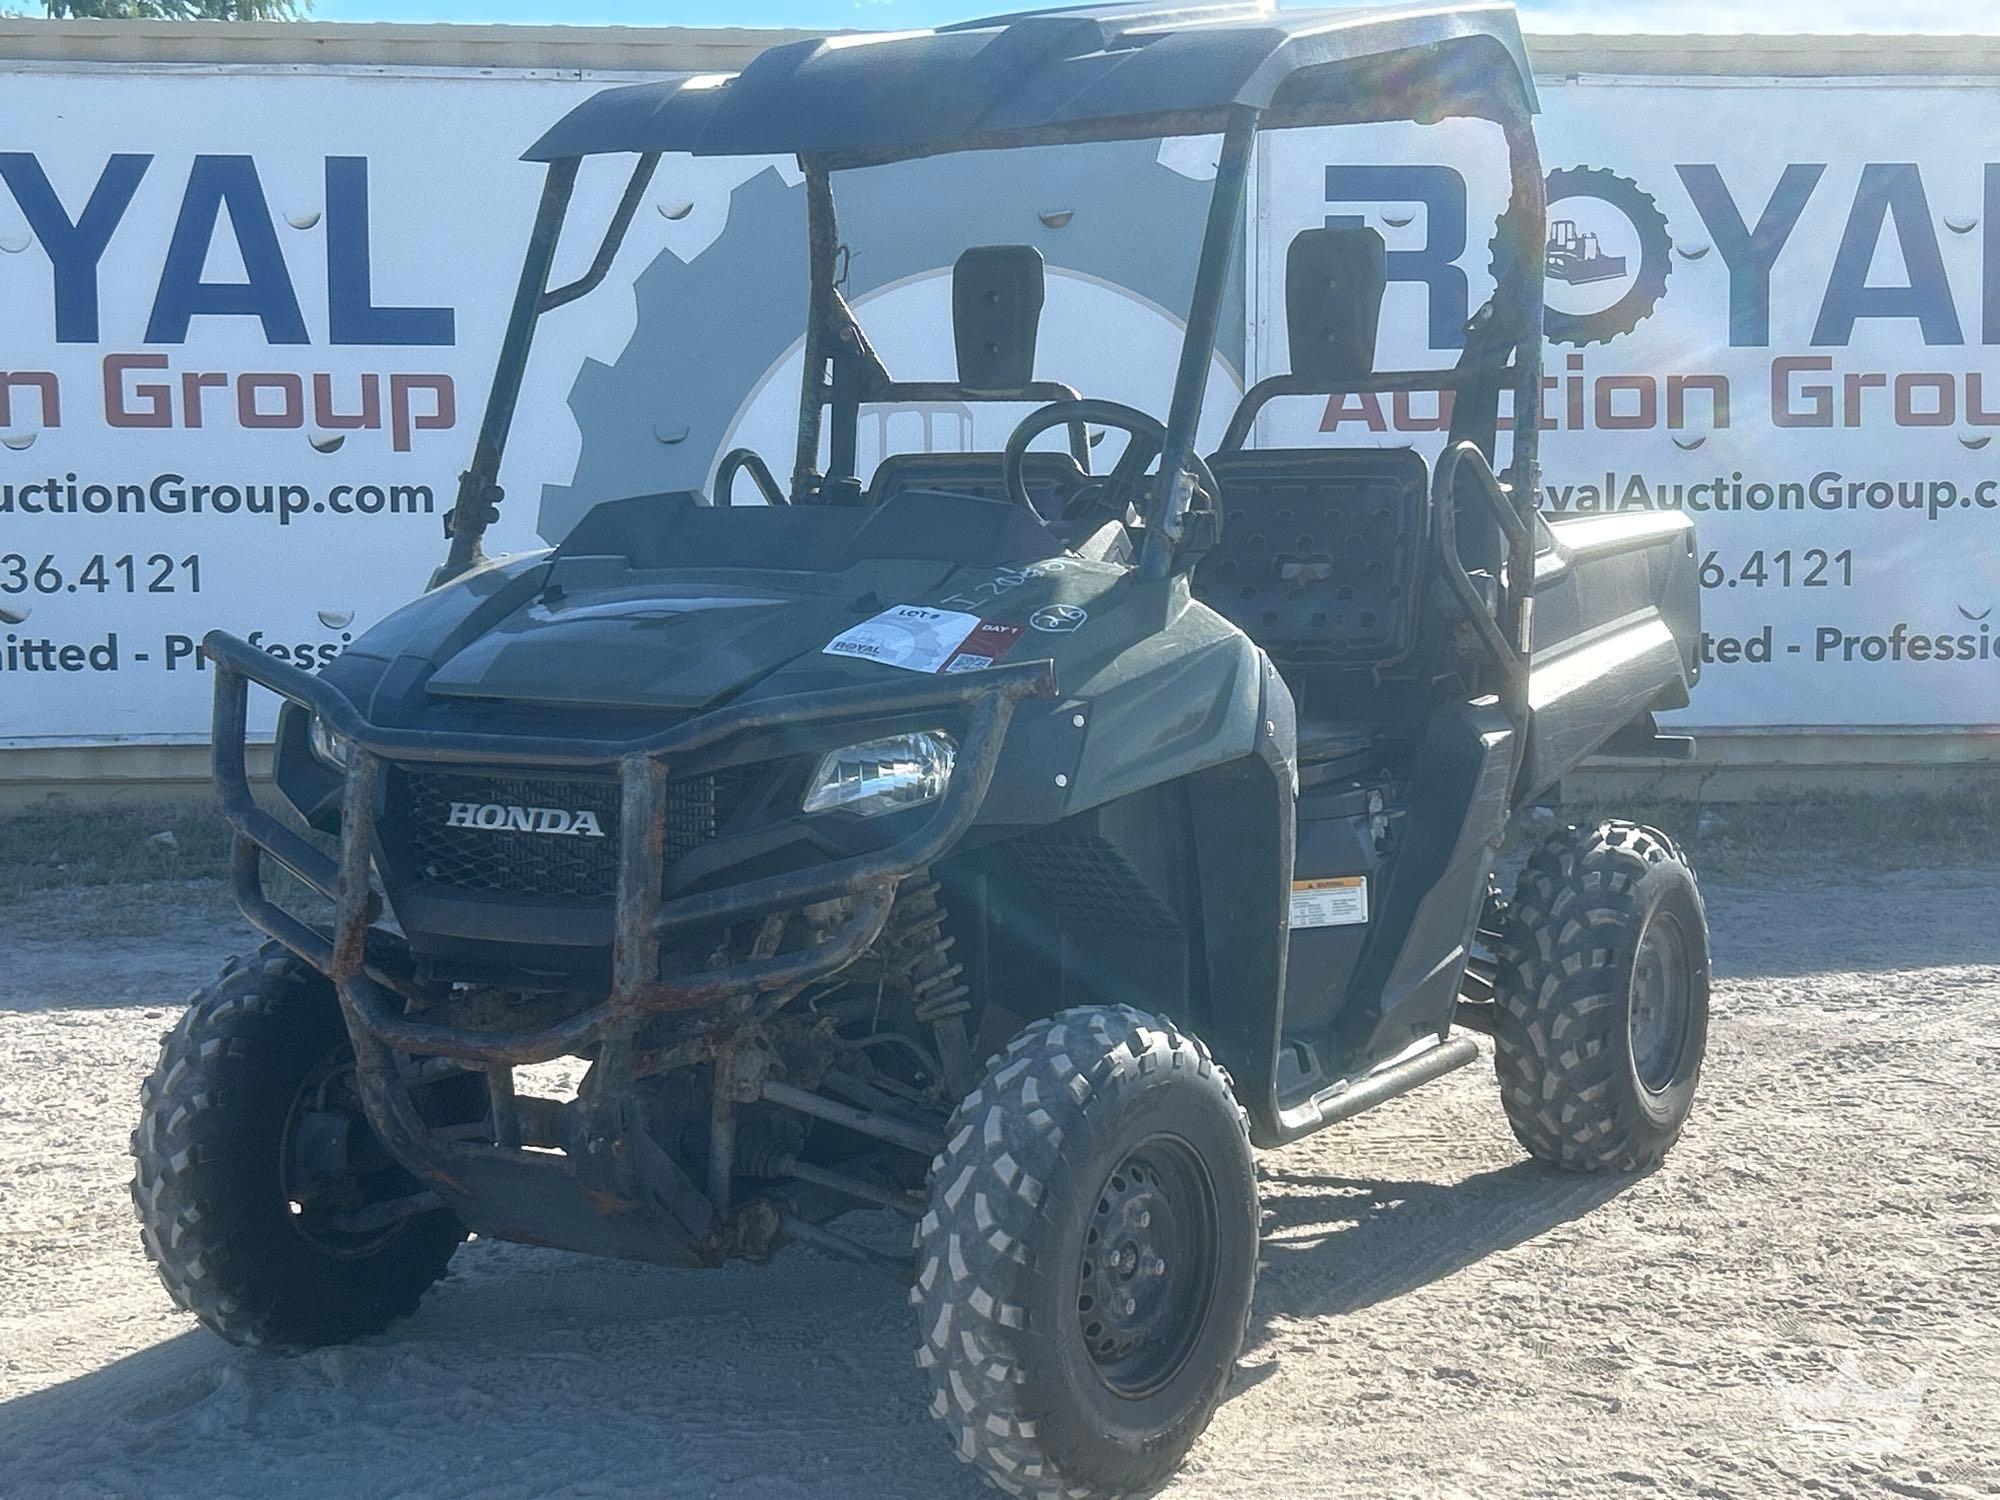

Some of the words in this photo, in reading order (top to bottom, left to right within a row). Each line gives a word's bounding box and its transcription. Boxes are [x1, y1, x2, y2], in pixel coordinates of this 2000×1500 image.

[0, 152, 456, 346] YAL
[103, 353, 456, 452] Group
[1318, 354, 1730, 433] Aution
[0, 553, 201, 594] 36.4121
[1699, 549, 1852, 588] 6.4121
[899, 608, 929, 621] LOT
[982, 624, 1009, 634] DAY
[135, 653, 149, 661] -
[1787, 644, 1801, 653] -
[1815, 622, 2000, 663] Professi
[446, 802, 605, 836] HONDA
